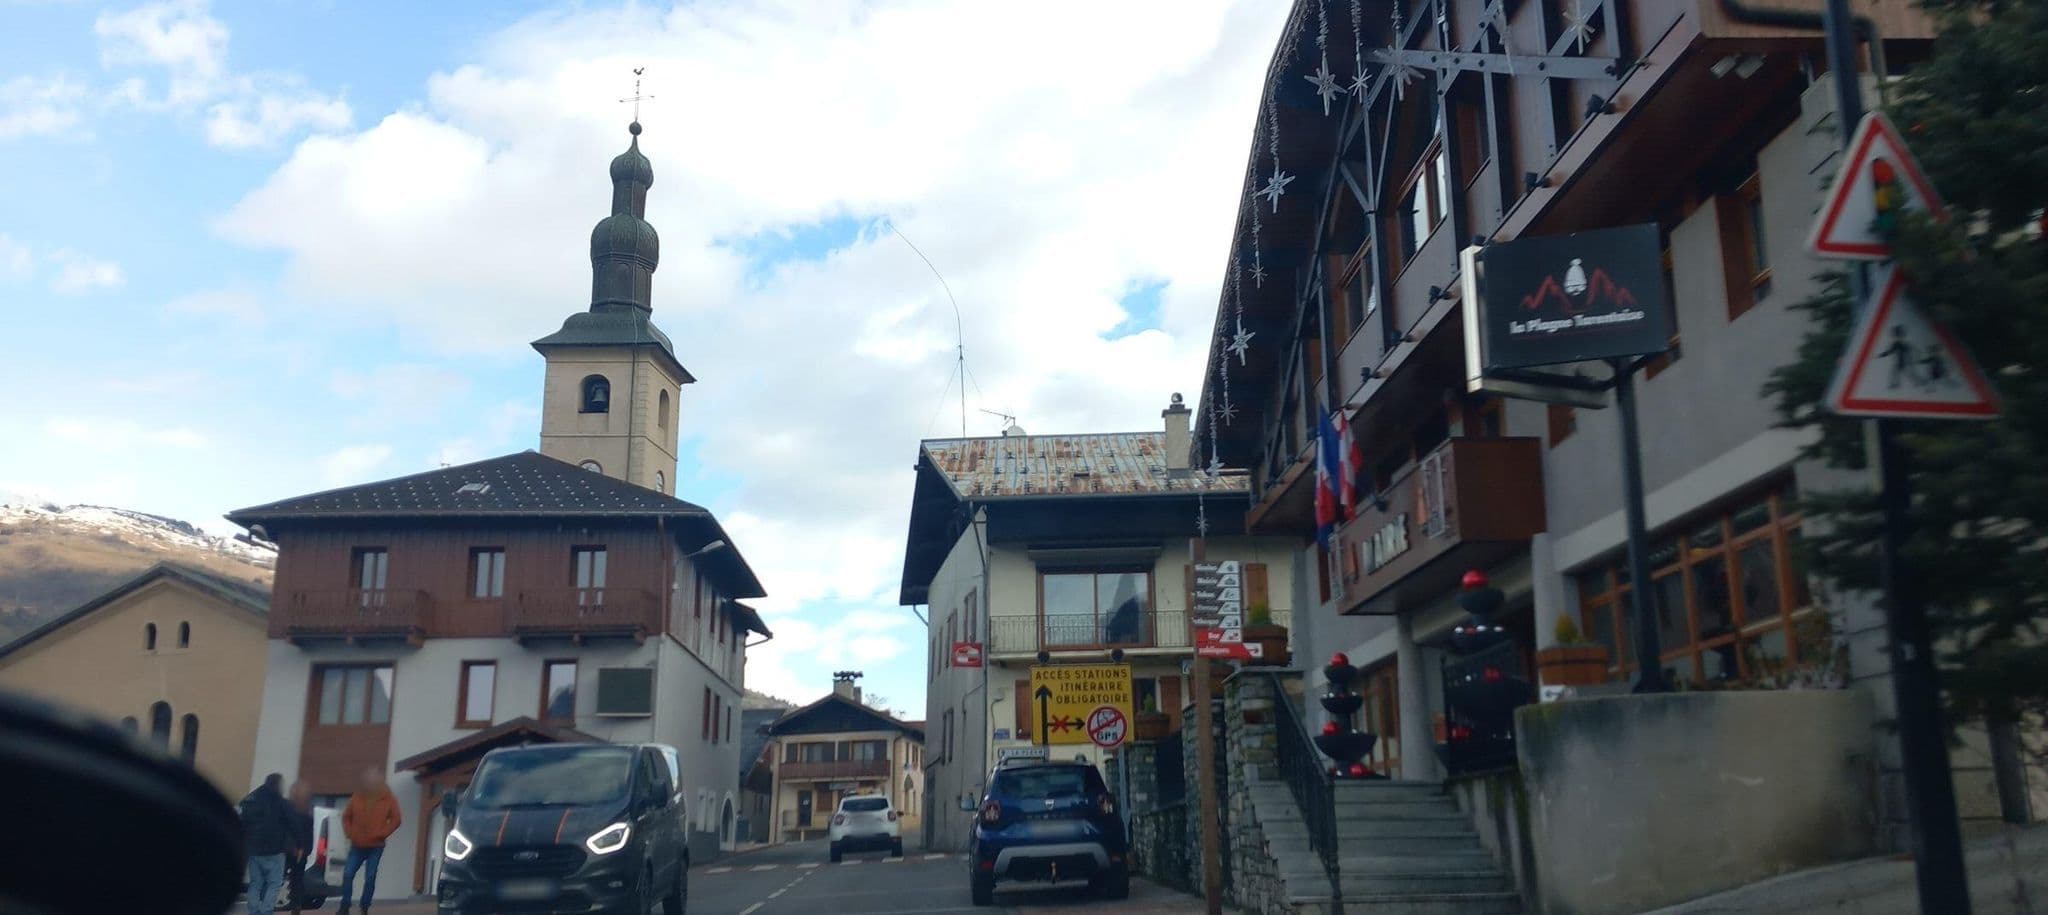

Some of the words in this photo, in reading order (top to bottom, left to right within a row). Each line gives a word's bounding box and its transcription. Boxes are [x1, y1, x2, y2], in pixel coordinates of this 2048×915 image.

[1526, 318, 1574, 333] Plagne
[1075, 669, 1128, 679] STATIONS
[1056, 694, 1129, 704] OBLIGATOIRE
[1097, 731, 1118, 740] GPS
